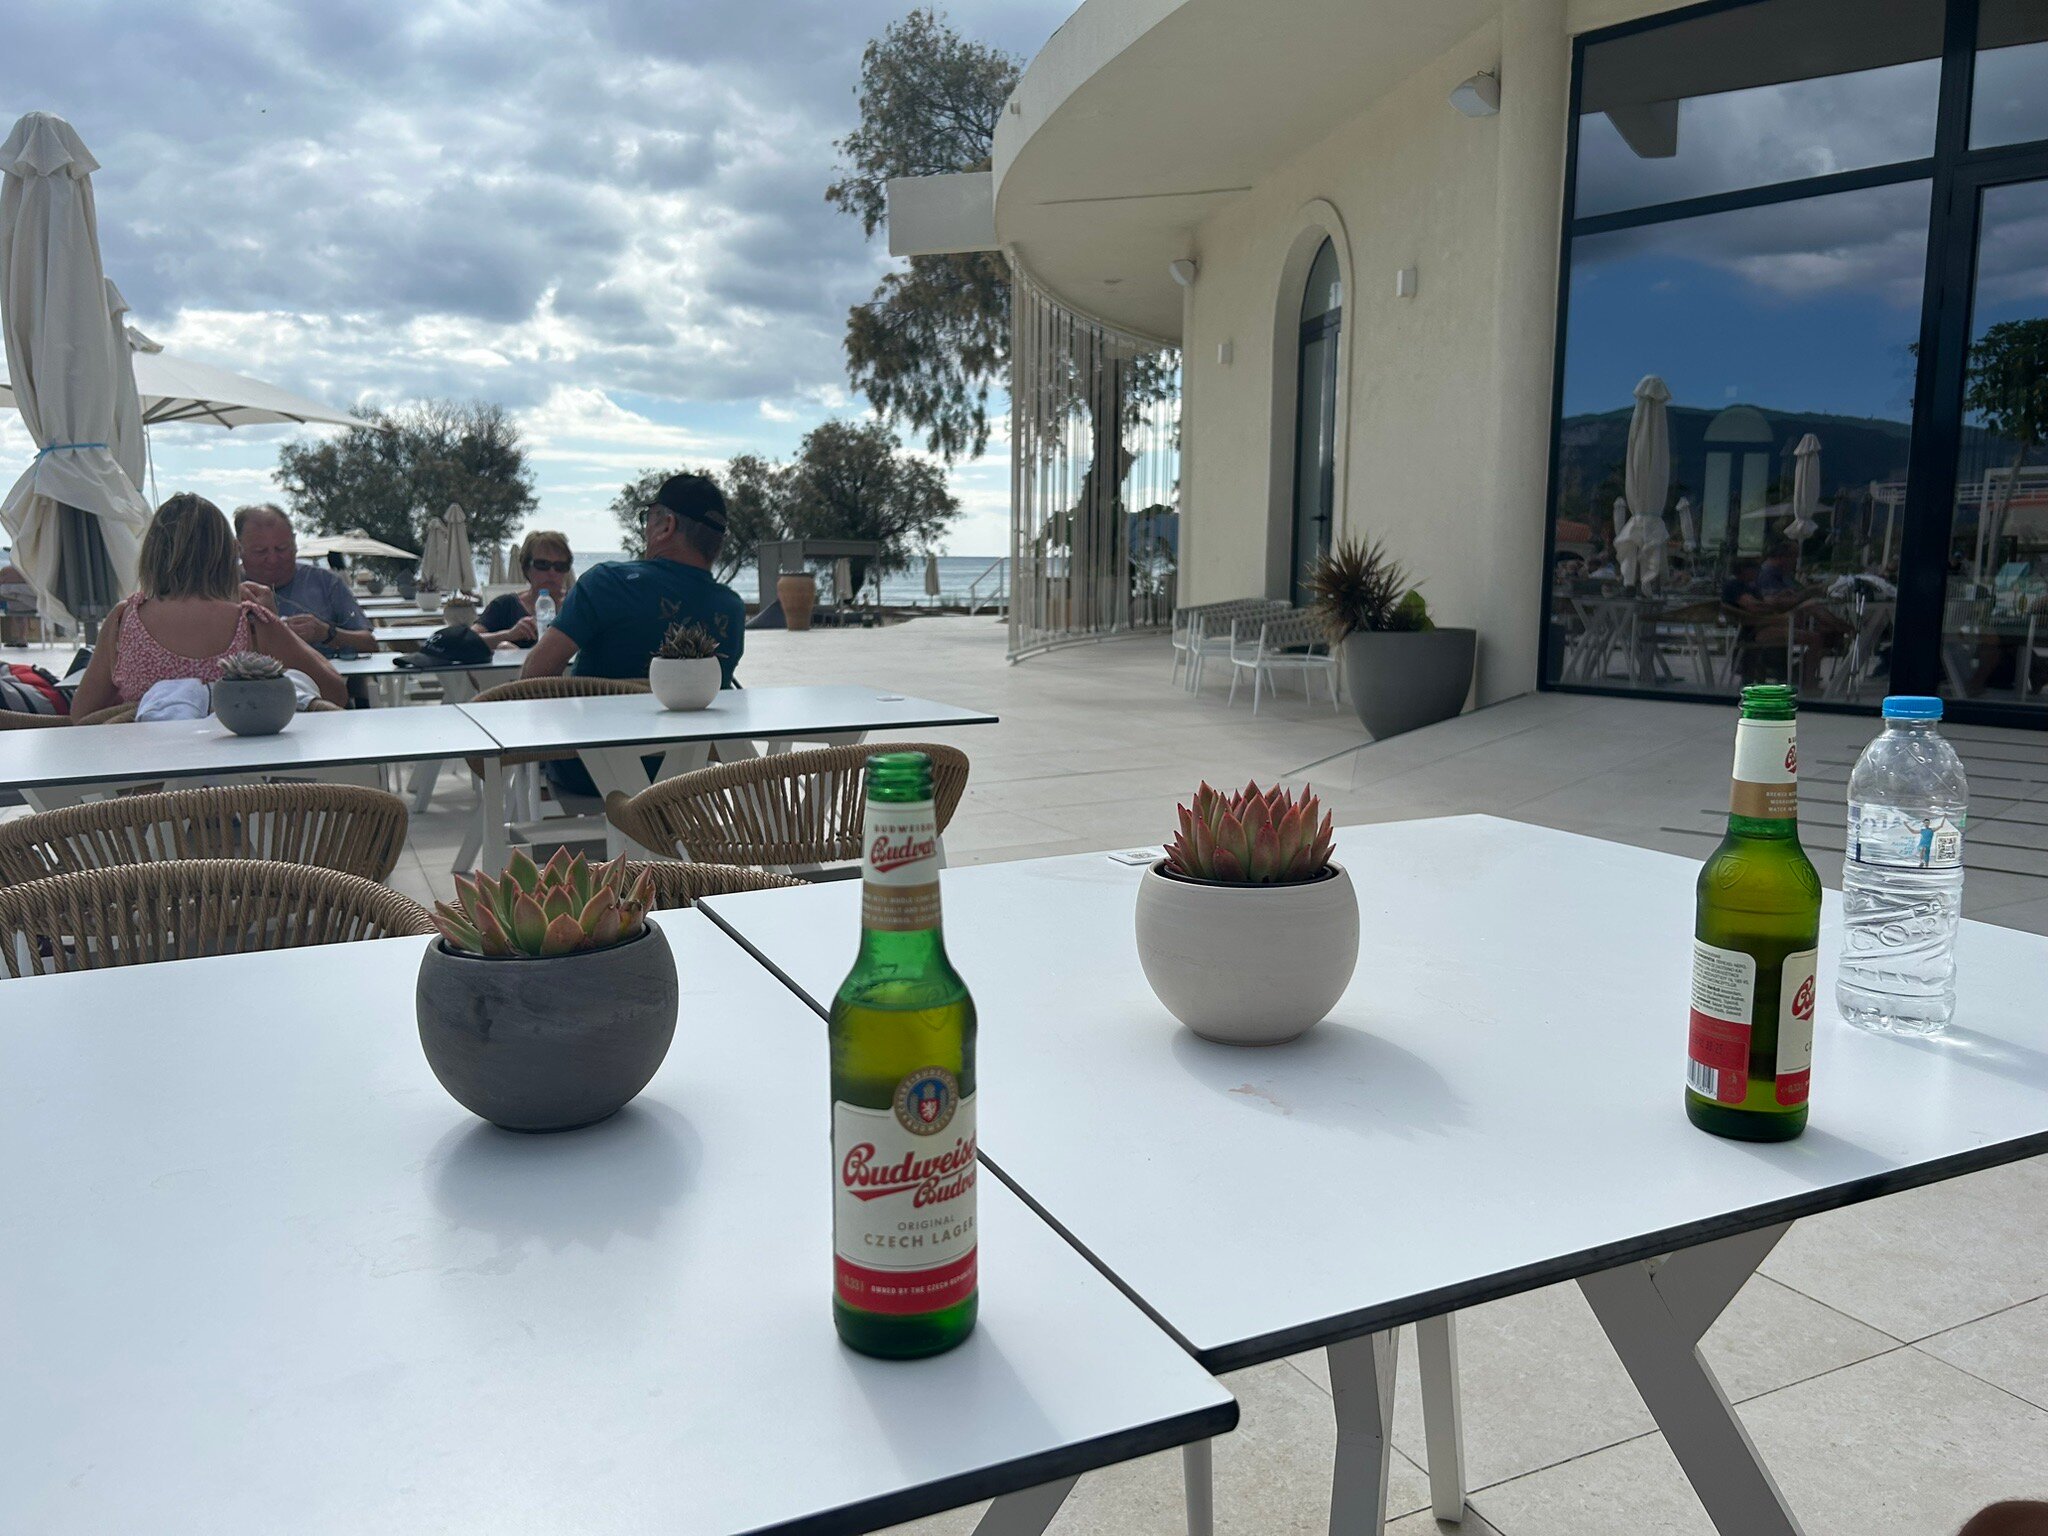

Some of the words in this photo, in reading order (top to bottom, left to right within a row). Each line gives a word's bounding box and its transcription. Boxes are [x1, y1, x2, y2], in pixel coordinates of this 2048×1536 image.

[897, 1214, 954, 1231] ORIGINAL
[864, 1232, 923, 1248] CZECH
[932, 1216, 974, 1245] LAGER
[911, 1286, 925, 1294] THE
